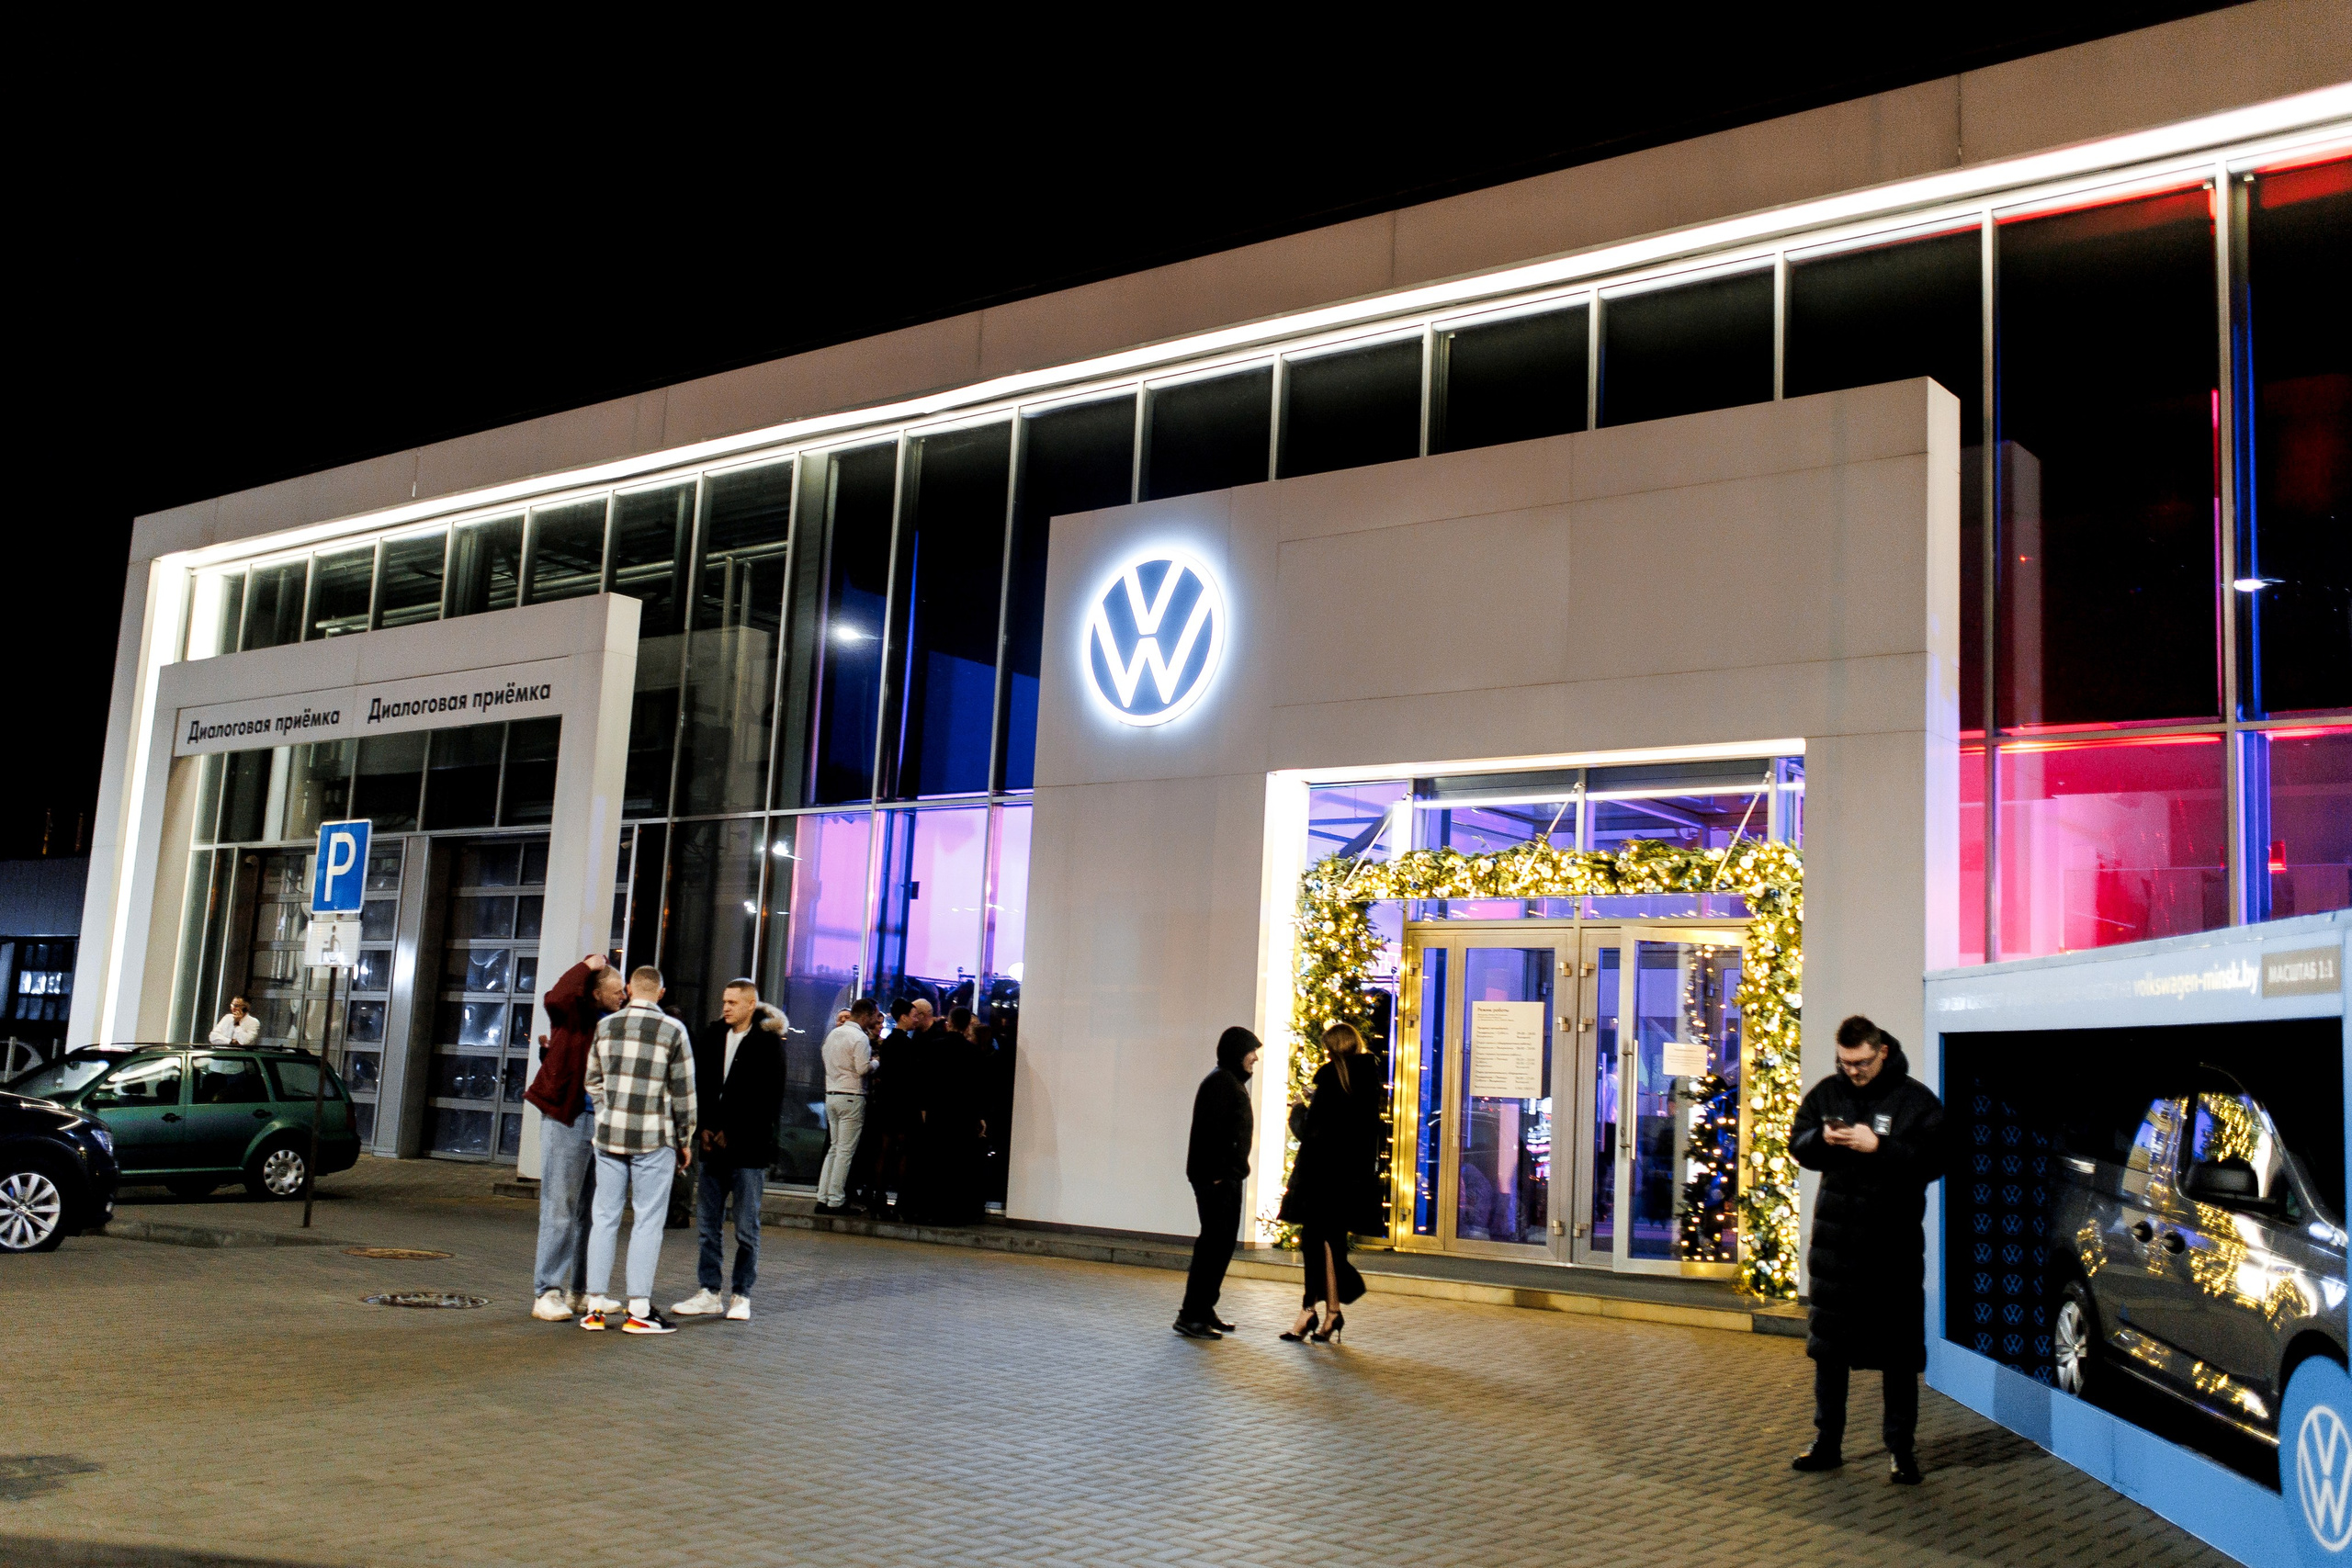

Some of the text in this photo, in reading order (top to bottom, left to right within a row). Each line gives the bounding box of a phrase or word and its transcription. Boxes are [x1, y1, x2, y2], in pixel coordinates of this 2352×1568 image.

[368, 682, 551, 724] Диалоговая приёмка
[187, 707, 341, 745] Диалоговая приёмка
[323, 831, 356, 902] P
[2133, 958, 2258, 1001] volkswagen-minsk.by
[2267, 959, 2334, 983] МАСШТАБ 1:1
